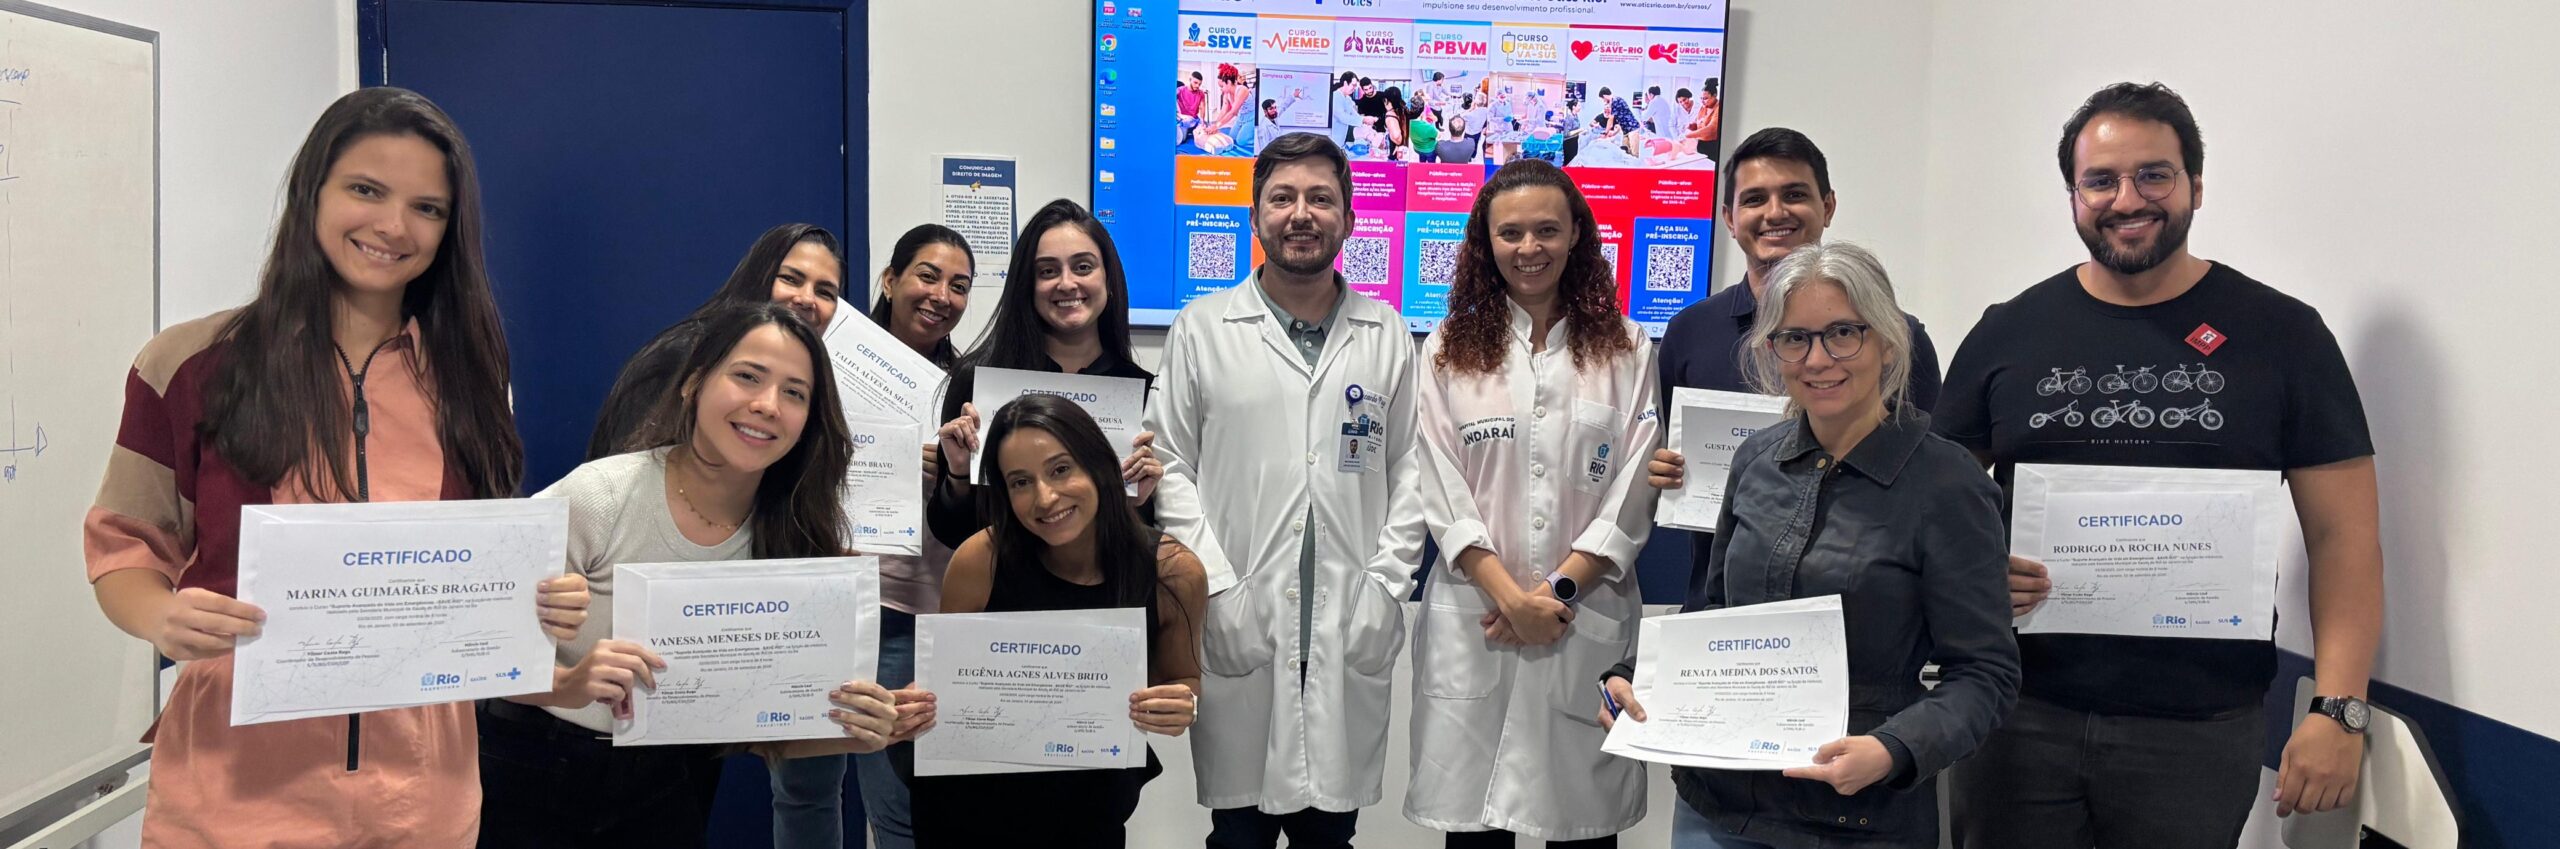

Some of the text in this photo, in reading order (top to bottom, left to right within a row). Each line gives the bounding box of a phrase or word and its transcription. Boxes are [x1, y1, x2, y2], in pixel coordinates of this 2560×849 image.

[1482, 3, 1548, 12] desenvolvimento
[1550, 6, 1595, 14] profissional.
[1208, 34, 1252, 49] SBVE
[1288, 36, 1330, 49] IEMED
[1366, 38, 1394, 46] MANE
[1434, 40, 1487, 56] PBVM
[1366, 46, 1404, 54] VA-SUS
[1517, 51, 1557, 59] VA-SUS
[1196, 212, 1214, 220] FAÇA
[1186, 220, 1240, 229] PRÉ-INSCRIÇÃO
[1354, 226, 1394, 234] -INSCRIÇÃO
[1426, 219, 1444, 228] FAÇA
[1417, 226, 1464, 236] PRÉ-INSCRIÇÃ
[1646, 232, 1698, 241] PRÉ-INSCRIÇÃO
[856, 344, 918, 389] CERTIFICADO
[834, 351, 914, 410] TALITA ALVES DA SILVA
[1637, 409, 1656, 422] SUS
[1370, 420, 1384, 436] Rio
[1463, 424, 1515, 446] ANDARAÍ
[1704, 442, 1738, 452] GUSTAV
[1590, 461, 1606, 475] RIO
[2078, 514, 2183, 528] CERTIFICADO
[2053, 541, 2212, 554] RODRIGO DA ROCHA NUNES
[343, 549, 472, 566] CERTIFICADO
[286, 581, 516, 600] MARINA GUIMARÃES BRAGATTO
[682, 601, 790, 617] CERTIFICADO
[2166, 616, 2186, 624] Rio
[651, 630, 821, 646] VANESSA MENESES DE SOUZA
[1708, 637, 1791, 652] CERTIFICADO
[990, 642, 1082, 656] CERTIFICADO
[958, 667, 1108, 681] EUGÊNIA AGNES ALVES BRITO
[1680, 666, 1818, 678] RENATA MEDINA DOS SANTOS
[436, 674, 460, 685] Rio
[770, 712, 790, 722] Rio
[1056, 744, 1074, 752] Rio
[1761, 742, 1780, 750] Rio
